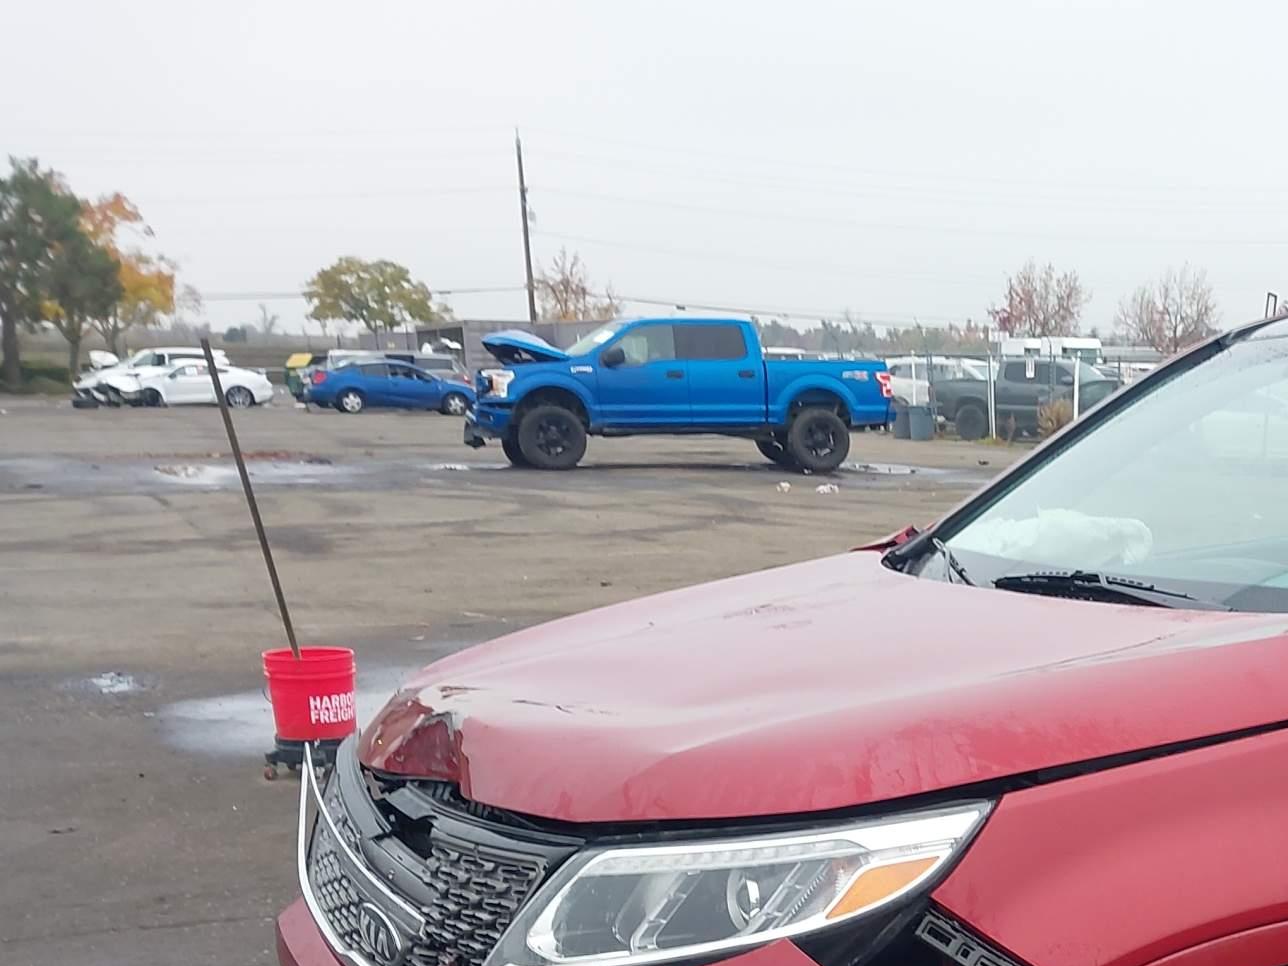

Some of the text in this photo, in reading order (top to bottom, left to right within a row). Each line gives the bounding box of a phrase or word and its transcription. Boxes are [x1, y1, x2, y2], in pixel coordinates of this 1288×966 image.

[309, 692, 354, 711] HARBO
[310, 705, 354, 724] FREIGH
[360, 909, 391, 960] KIA
